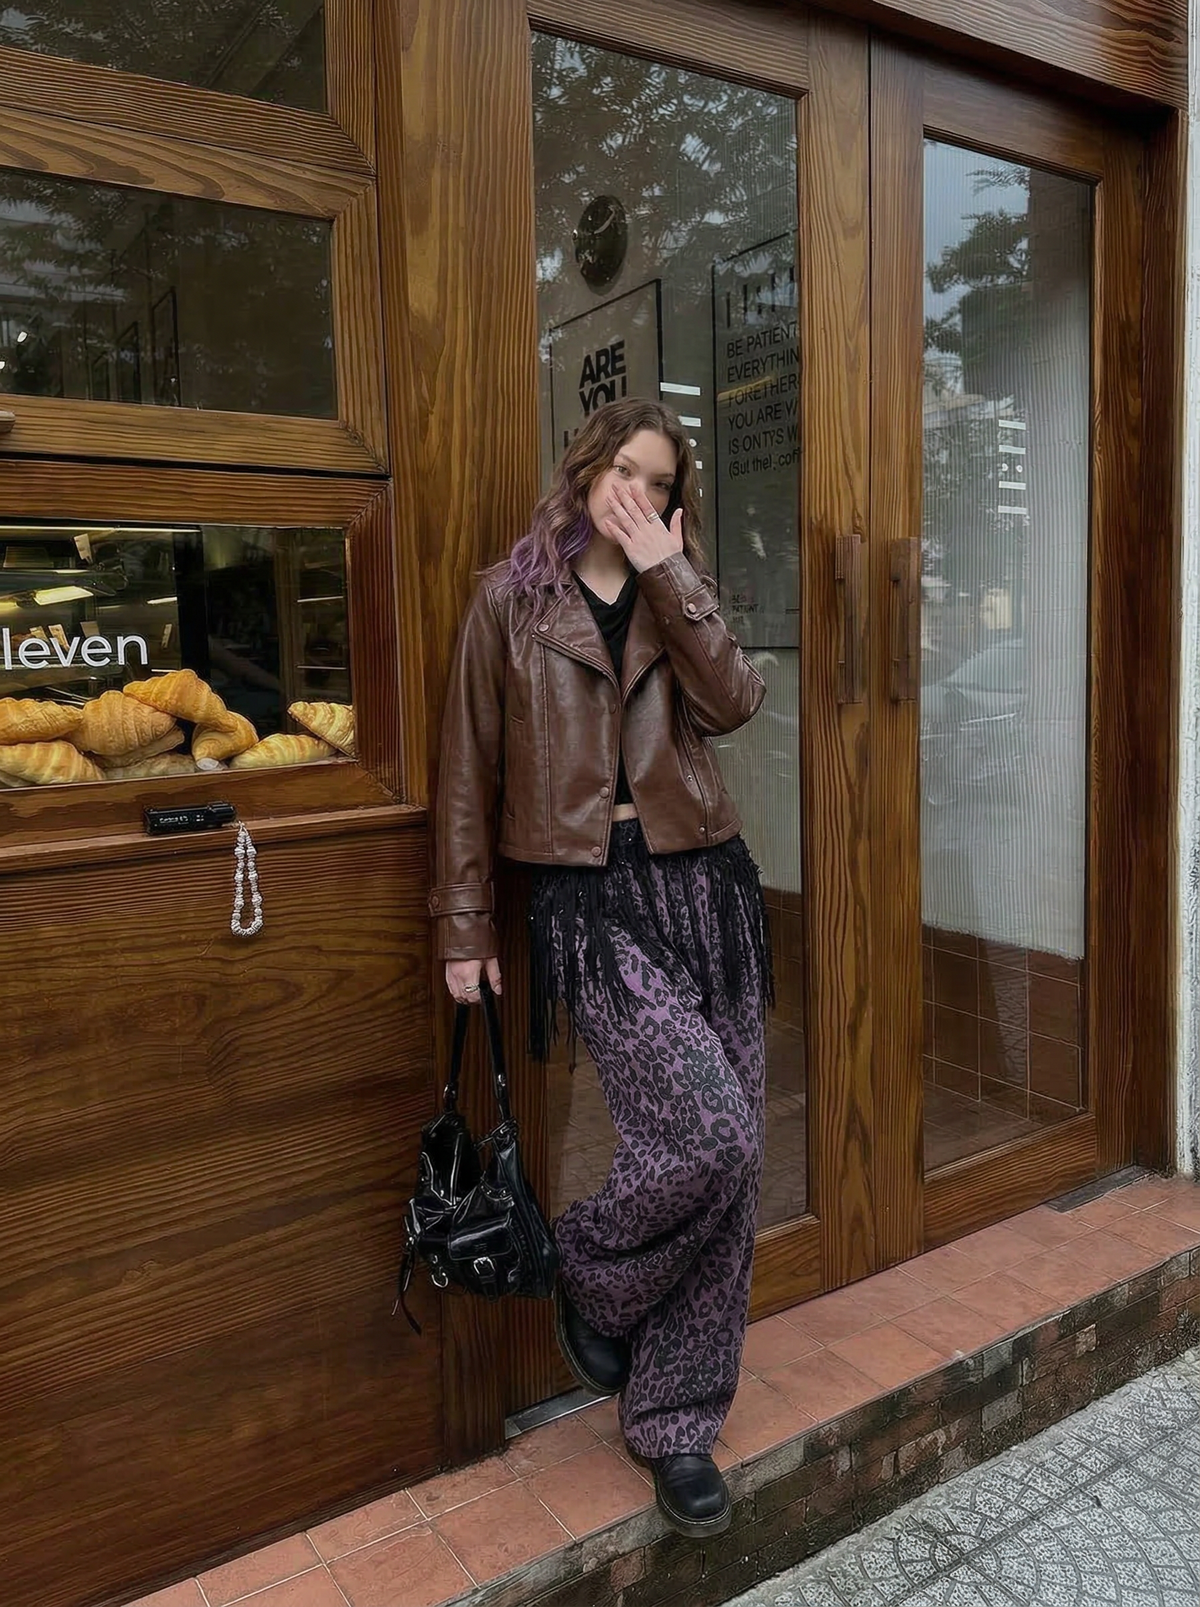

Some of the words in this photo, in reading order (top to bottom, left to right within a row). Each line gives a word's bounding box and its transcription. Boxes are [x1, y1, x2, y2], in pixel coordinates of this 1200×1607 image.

[578, 340, 627, 389] ARE
[726, 338, 743, 359] BE
[728, 410, 753, 431] YOU
[756, 402, 782, 425] ARE
[2, 627, 149, 671] leven
